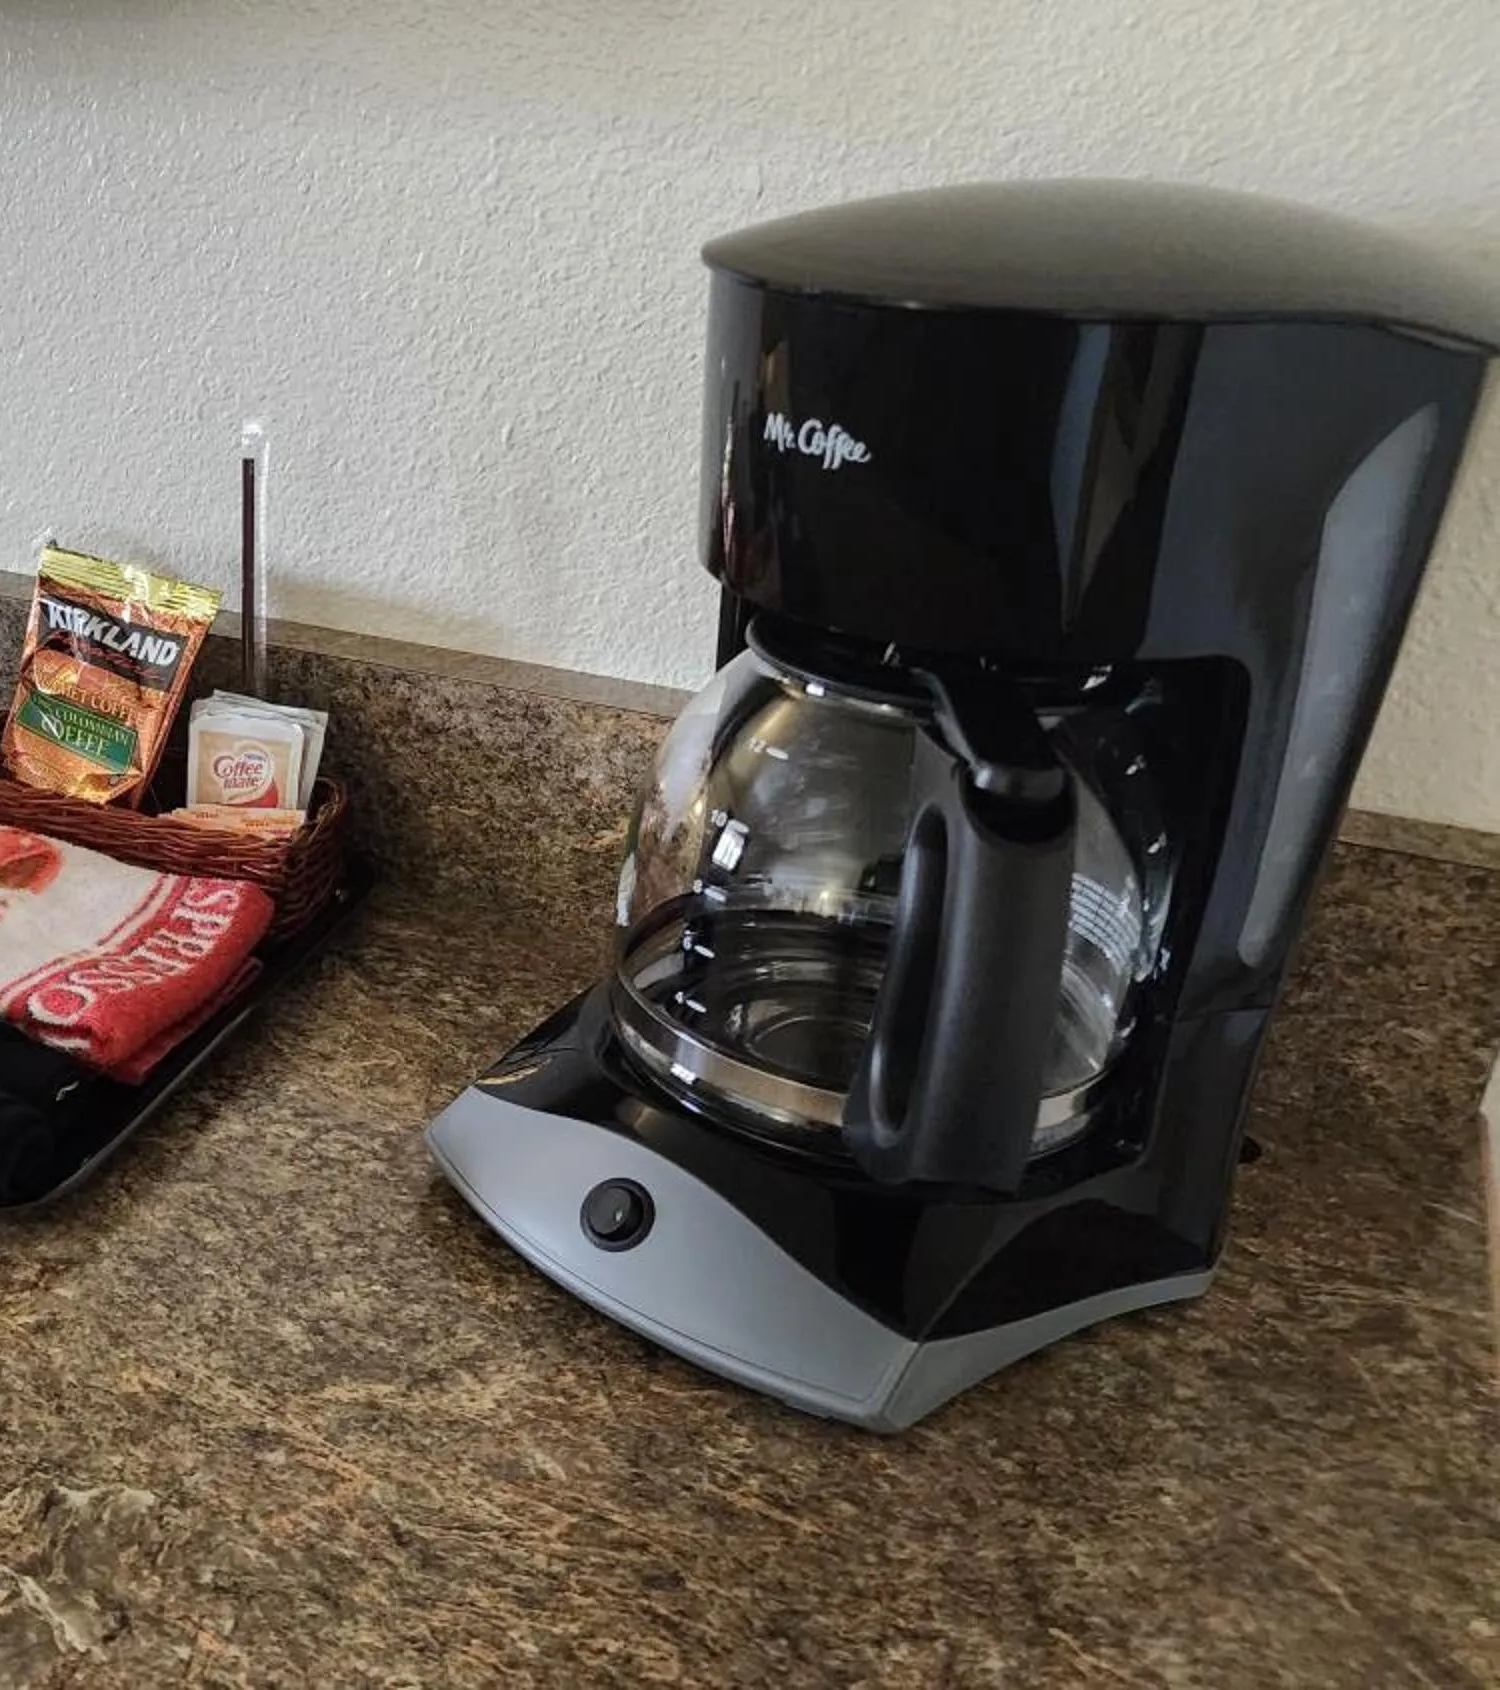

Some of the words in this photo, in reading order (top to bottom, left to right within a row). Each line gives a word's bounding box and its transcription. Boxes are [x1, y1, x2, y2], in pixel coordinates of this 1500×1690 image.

[797, 417, 872, 470] Coffee
[47, 603, 179, 666] KIRKLAND
[213, 755, 263, 778] Coffee
[26, 880, 243, 1025] SPRESSO
